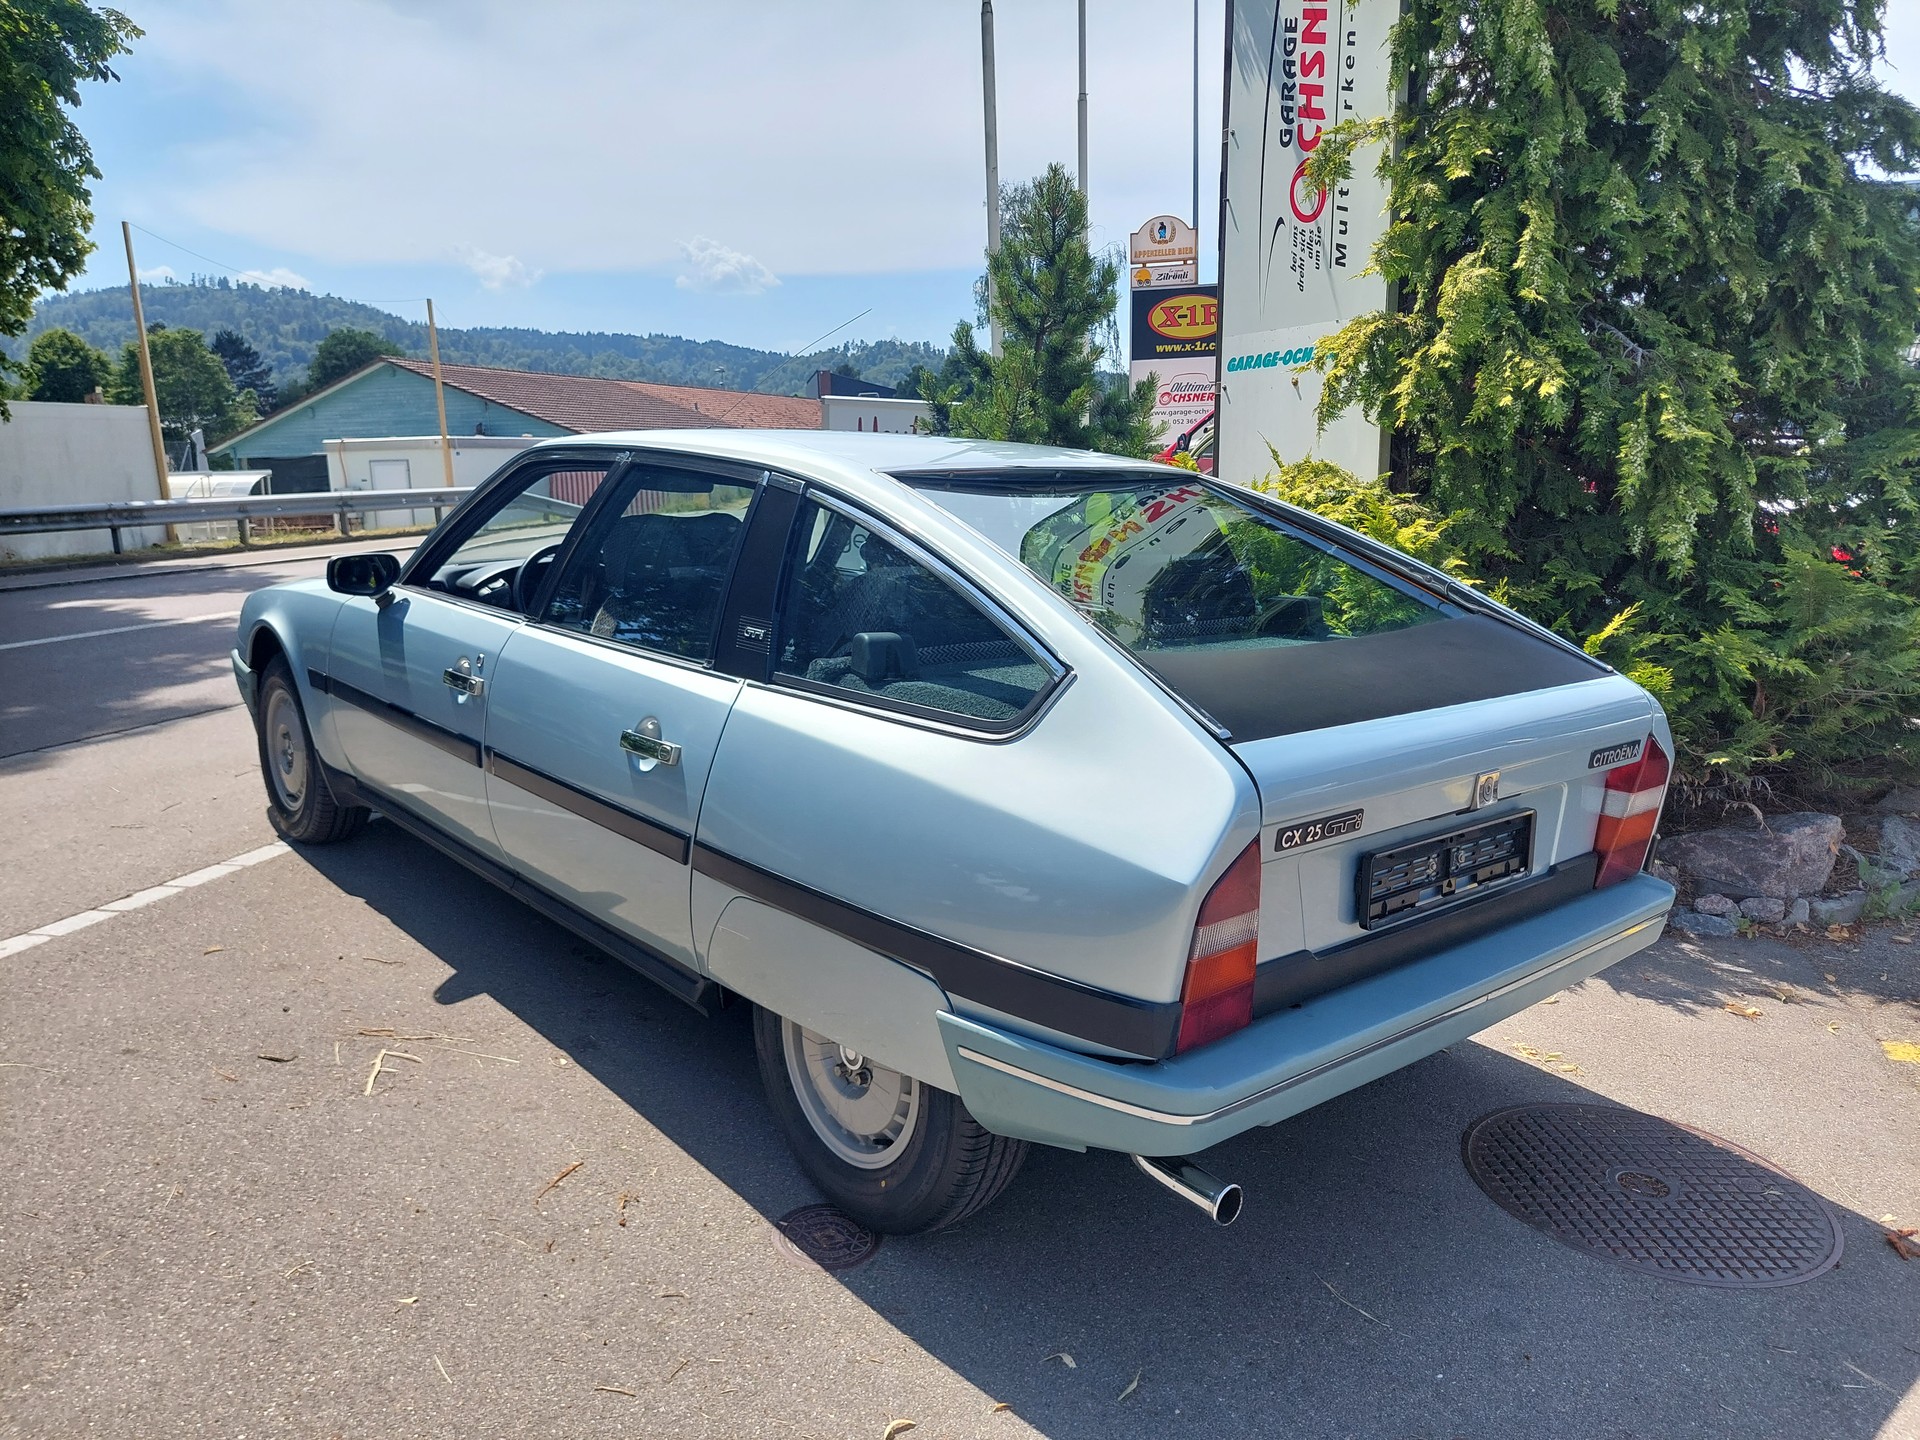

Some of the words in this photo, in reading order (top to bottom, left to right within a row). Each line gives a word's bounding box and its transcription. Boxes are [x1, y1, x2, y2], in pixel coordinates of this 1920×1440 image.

[1279, 17, 1298, 148] GARAGE
[1290, 0, 1328, 223] OCHSN
[1134, 248, 1176, 258] APPENZELLER
[1178, 247, 1193, 255] BIER
[1306, 229, 1315, 259] alles
[1315, 250, 1320, 270] um
[1297, 257, 1305, 292] dreht
[1158, 304, 1217, 328] X-1R
[1156, 341, 1216, 353] www.x-1r.c
[1227, 347, 1316, 372] GARAGE-OCH
[1159, 392, 1215, 405] OCHSNER
[1170, 382, 1215, 392] Oldtimer
[1593, 744, 1633, 766] CITROËN
[1282, 829, 1302, 847] CX
[1306, 824, 1322, 842] 25
[1325, 813, 1362, 836] GTi
